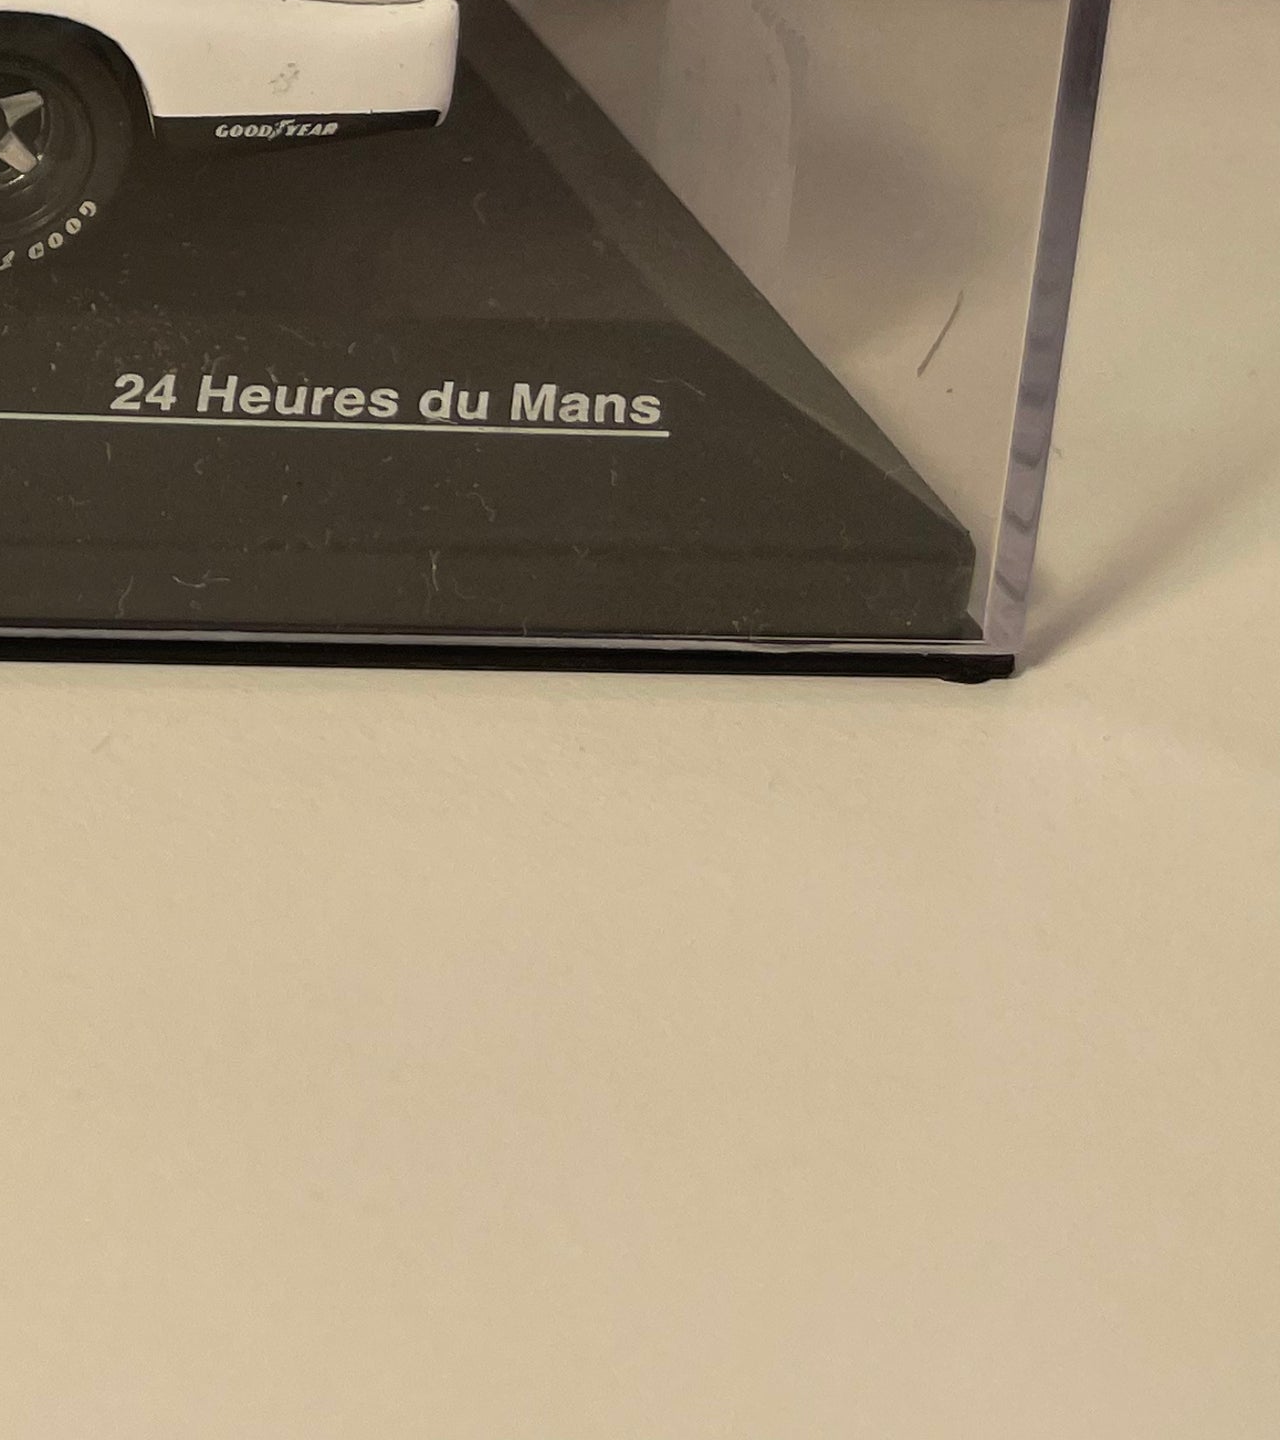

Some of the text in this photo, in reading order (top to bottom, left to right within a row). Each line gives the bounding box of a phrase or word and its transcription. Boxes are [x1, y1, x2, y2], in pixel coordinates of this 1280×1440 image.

[215, 119, 339, 141] GOODYEAR
[109, 373, 661, 425] 24 Heures du Mans
